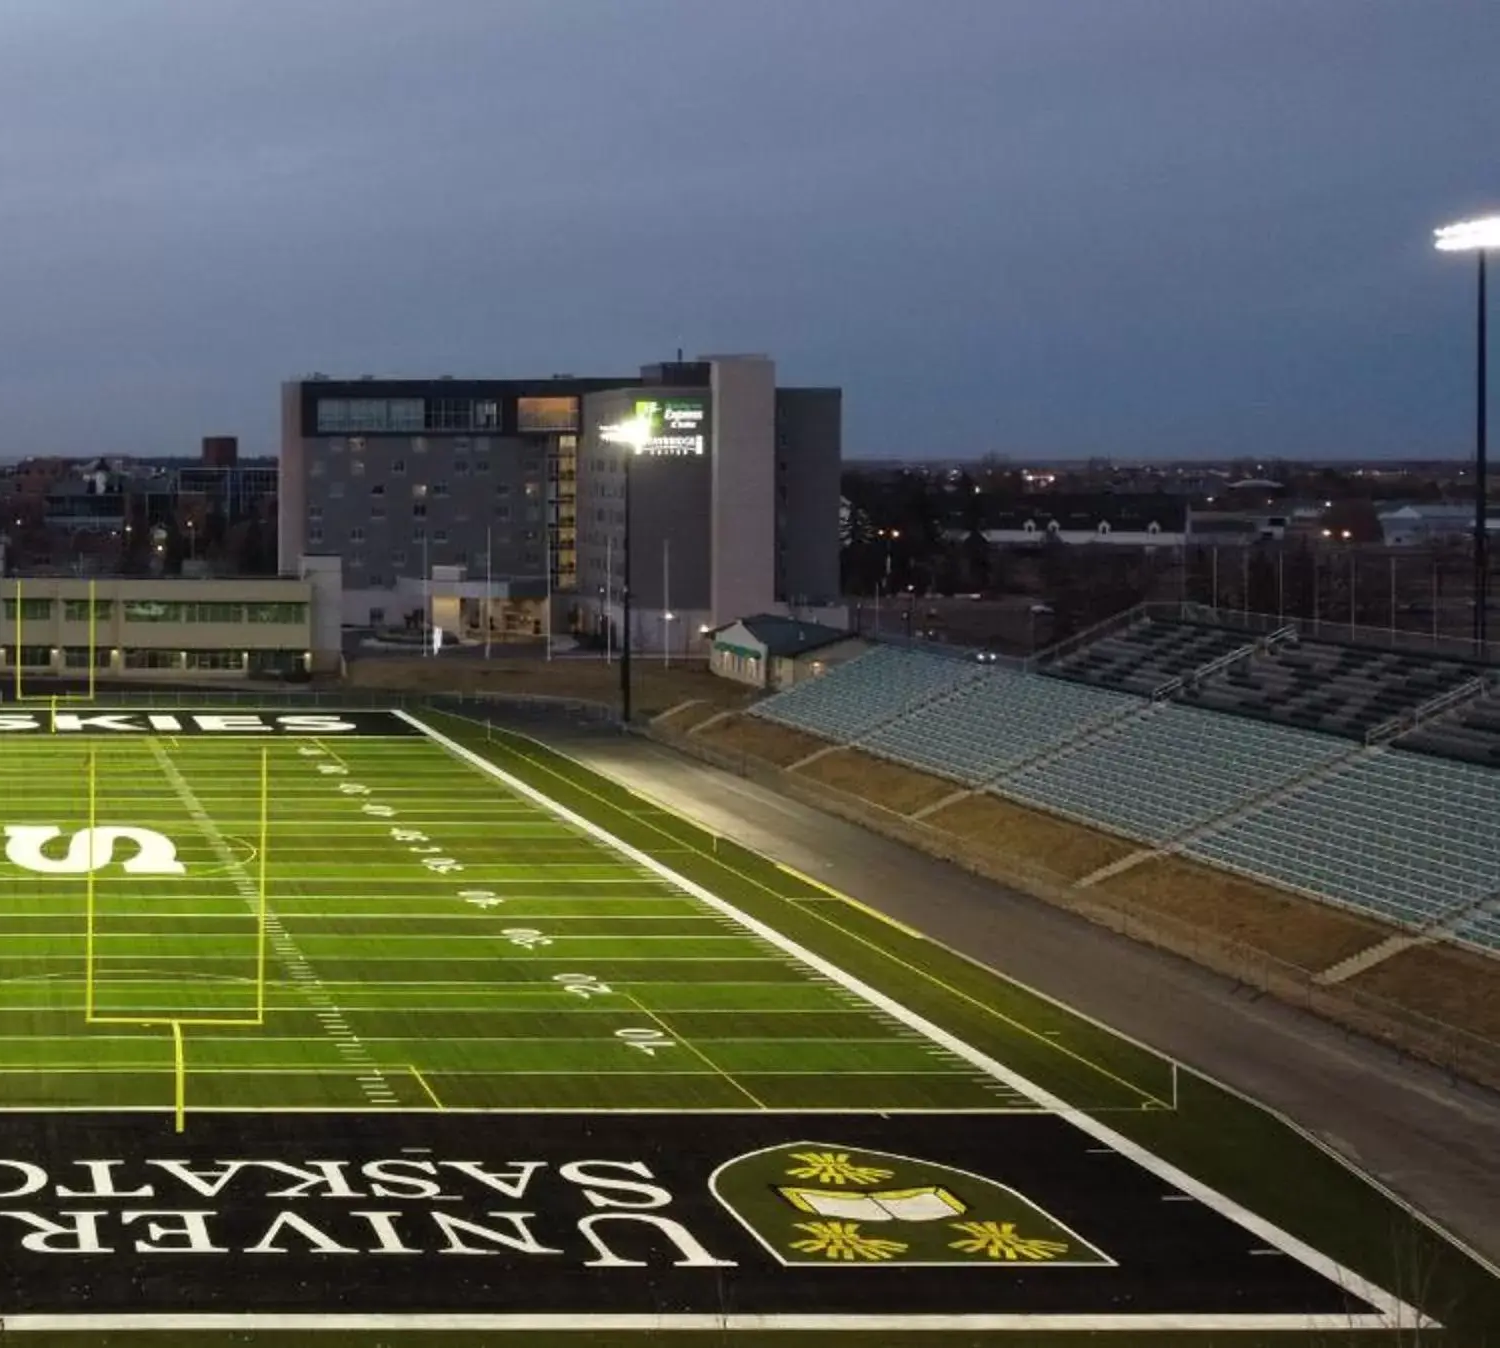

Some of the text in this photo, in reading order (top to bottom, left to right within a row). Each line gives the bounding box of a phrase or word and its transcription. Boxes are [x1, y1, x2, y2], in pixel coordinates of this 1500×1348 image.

[3, 825, 186, 873] S
[553, 973, 613, 994] 20
[615, 1029, 677, 1047] 10
